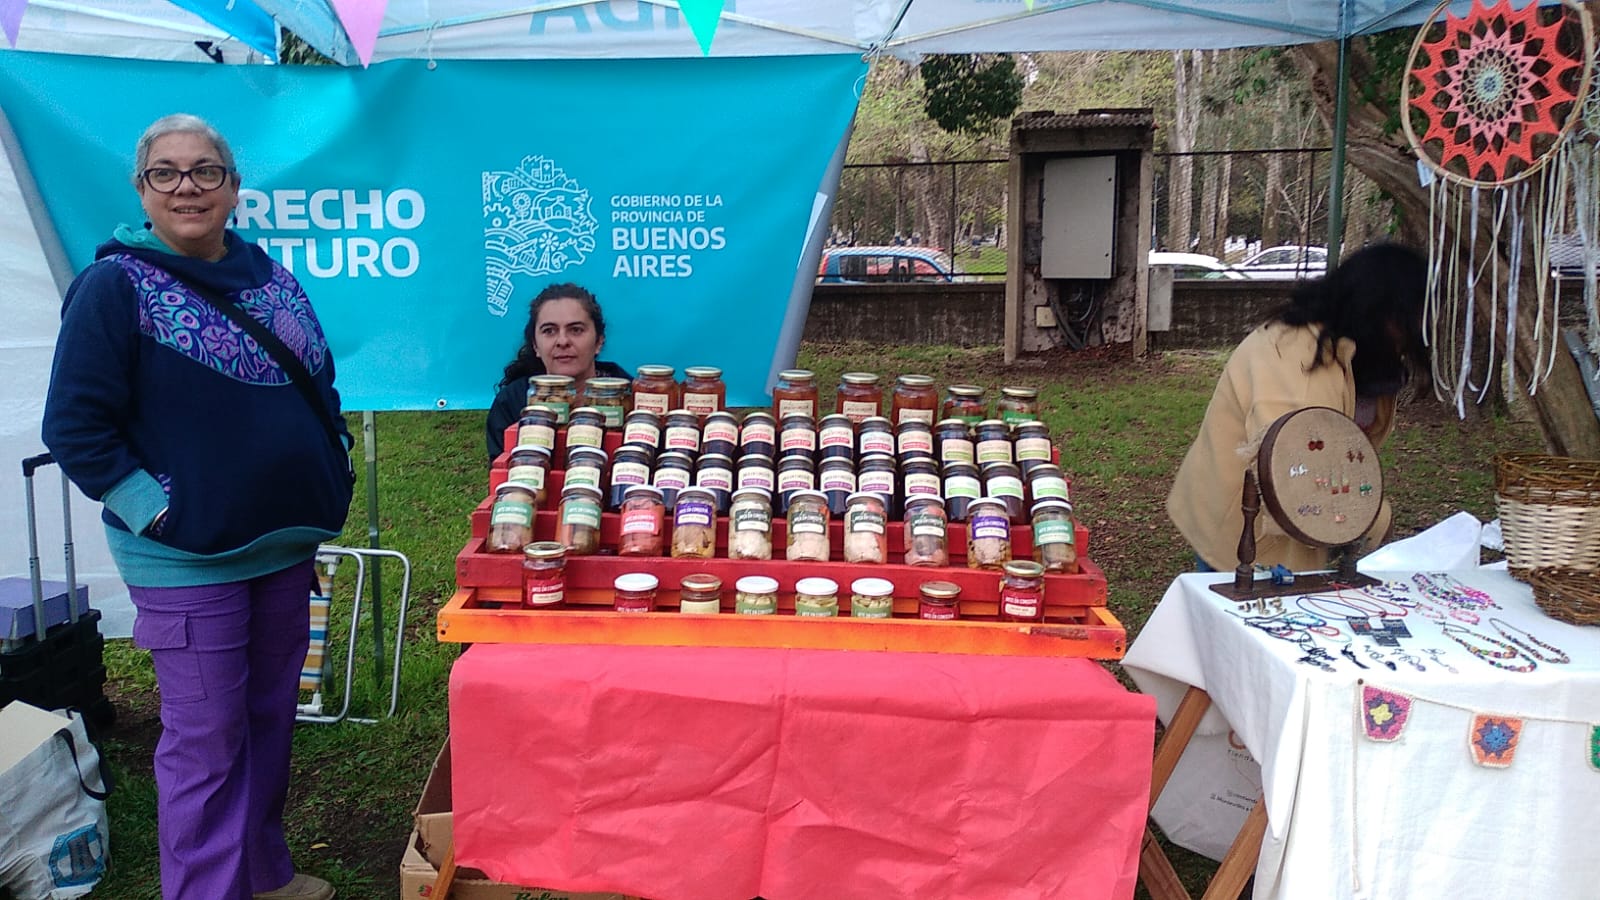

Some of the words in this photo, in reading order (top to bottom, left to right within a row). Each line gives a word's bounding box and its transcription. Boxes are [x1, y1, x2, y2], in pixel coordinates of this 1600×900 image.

[226, 188, 425, 230] RECHO
[611, 194, 680, 207] GOBIERNO
[684, 194, 702, 207] DE
[705, 194, 723, 207] LA
[611, 210, 684, 223] PROVINCIA
[687, 210, 705, 222] DE
[612, 226, 726, 250] BUENOS
[257, 237, 420, 278] TURO
[612, 254, 693, 278] AIRES
